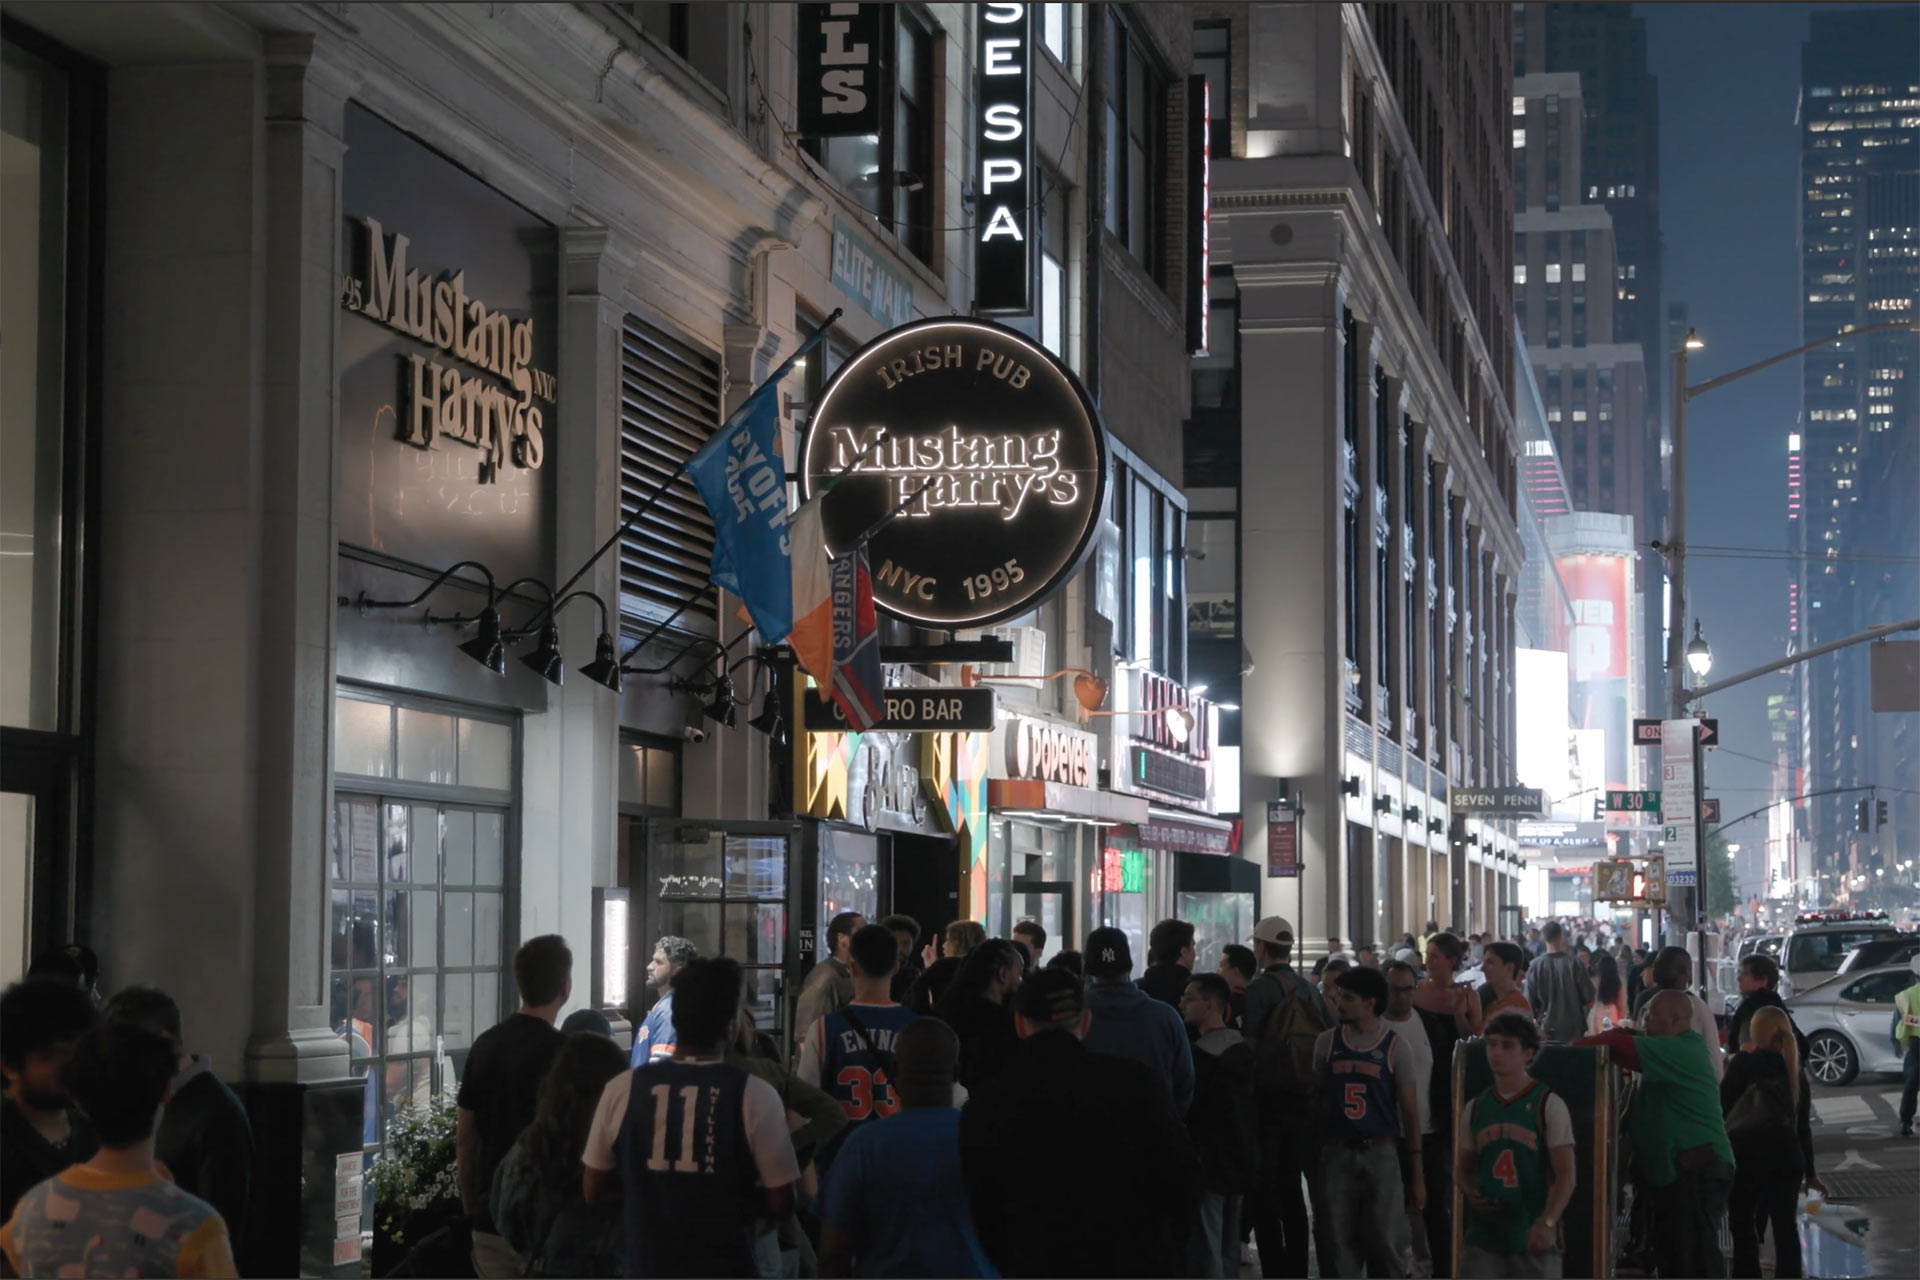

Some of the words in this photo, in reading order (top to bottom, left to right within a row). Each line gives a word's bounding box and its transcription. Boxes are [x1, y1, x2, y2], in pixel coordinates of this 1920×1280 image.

[820, 3, 869, 115] LS
[981, 104, 1023, 242] SPA
[834, 231, 873, 301] ELITE
[364, 215, 533, 409] Mustang
[876, 345, 962, 389] IRISH
[976, 348, 1032, 389] PUB
[408, 352, 544, 469] Harry's
[829, 425, 1060, 480] Mustang
[889, 471, 1080, 521] Harry's
[877, 559, 936, 600] NYC
[962, 558, 1025, 600] 1995
[922, 698, 963, 720] BAR
[1645, 726, 1662, 738] ON
[1454, 794, 1495, 806] SEVEN
[1503, 793, 1539, 806] PENN
[1613, 793, 1622, 808] W
[1628, 793, 1643, 809] 30
[1667, 828, 1675, 841] 2
[837, 1066, 901, 1119] 33
[1345, 1083, 1367, 1119] 5
[647, 1084, 699, 1171] 11
[705, 1086, 720, 1173] NTILIKINA
[1493, 1149, 1519, 1187] 4
